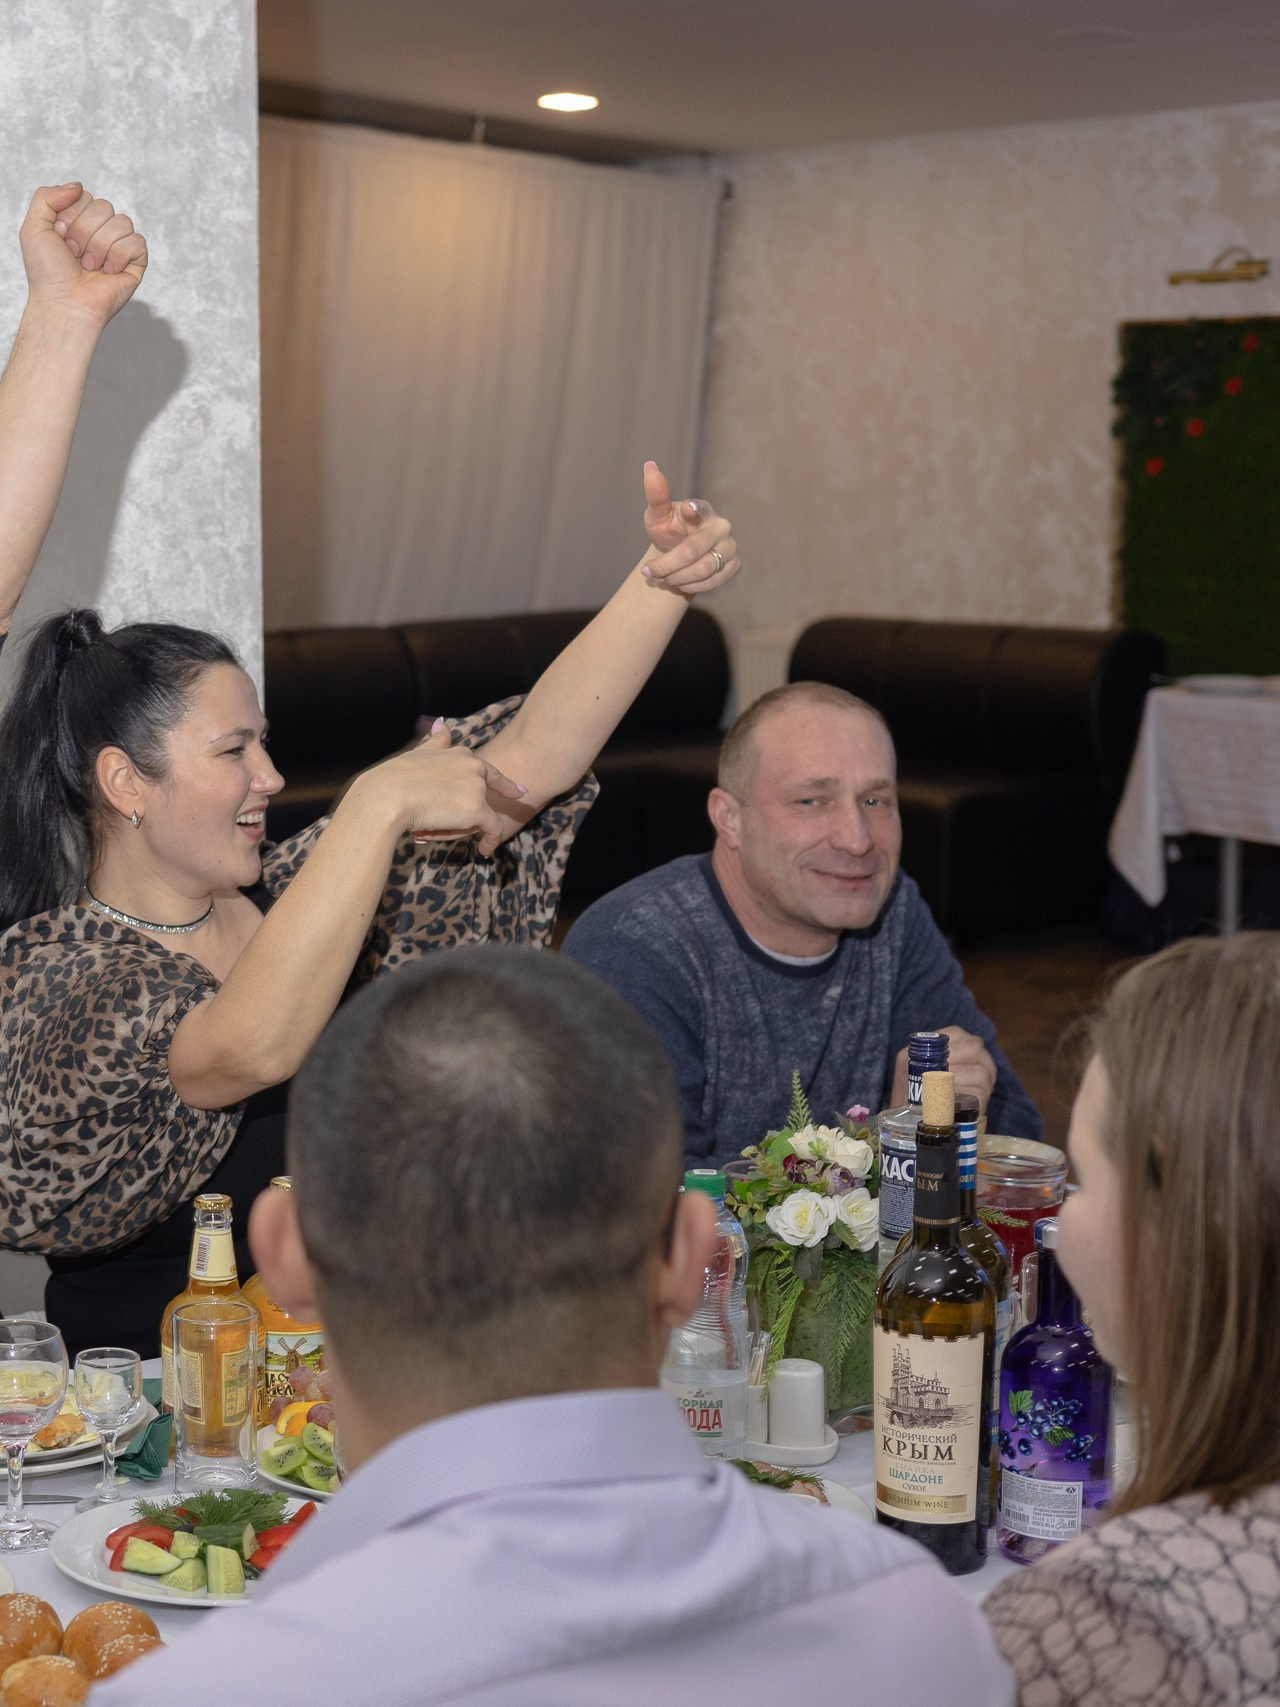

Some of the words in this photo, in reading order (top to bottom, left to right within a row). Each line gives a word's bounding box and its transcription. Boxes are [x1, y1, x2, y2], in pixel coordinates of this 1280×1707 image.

[882, 1154, 916, 1182] ХАС
[882, 1425, 957, 1443] ИСТОРИЧЕСКИЙ
[882, 1434, 955, 1461] КРЫМ
[889, 1468, 944, 1484] ШАРДОНЕ
[902, 1483, 927, 1492] СУХОЕ
[885, 1493, 920, 1507] REMIUM
